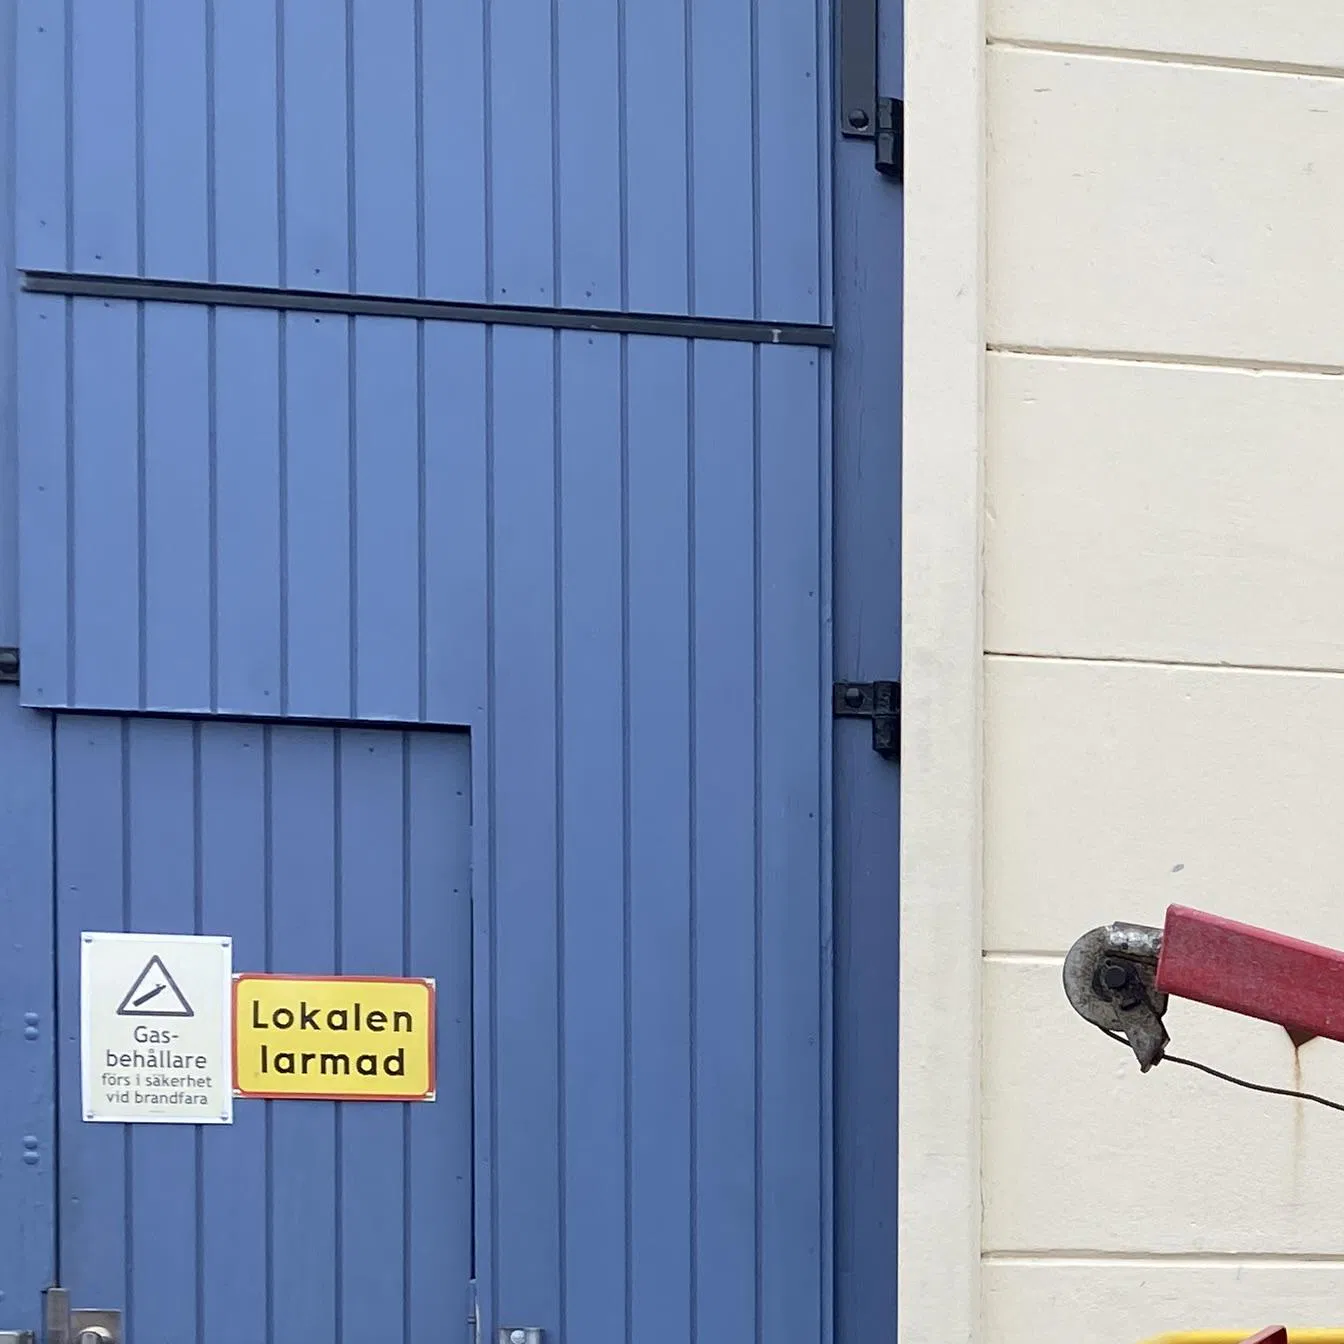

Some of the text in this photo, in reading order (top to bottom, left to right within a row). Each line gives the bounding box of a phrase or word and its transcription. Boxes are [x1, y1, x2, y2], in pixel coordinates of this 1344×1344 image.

[252, 999, 414, 1033] Lokalen
[133, 1025, 179, 1044] Gas-
[106, 1048, 207, 1069] behållare
[260, 1045, 406, 1077] larmad
[102, 1073, 213, 1088] förs i säkerhet
[106, 1091, 208, 1105] vid brandfara
